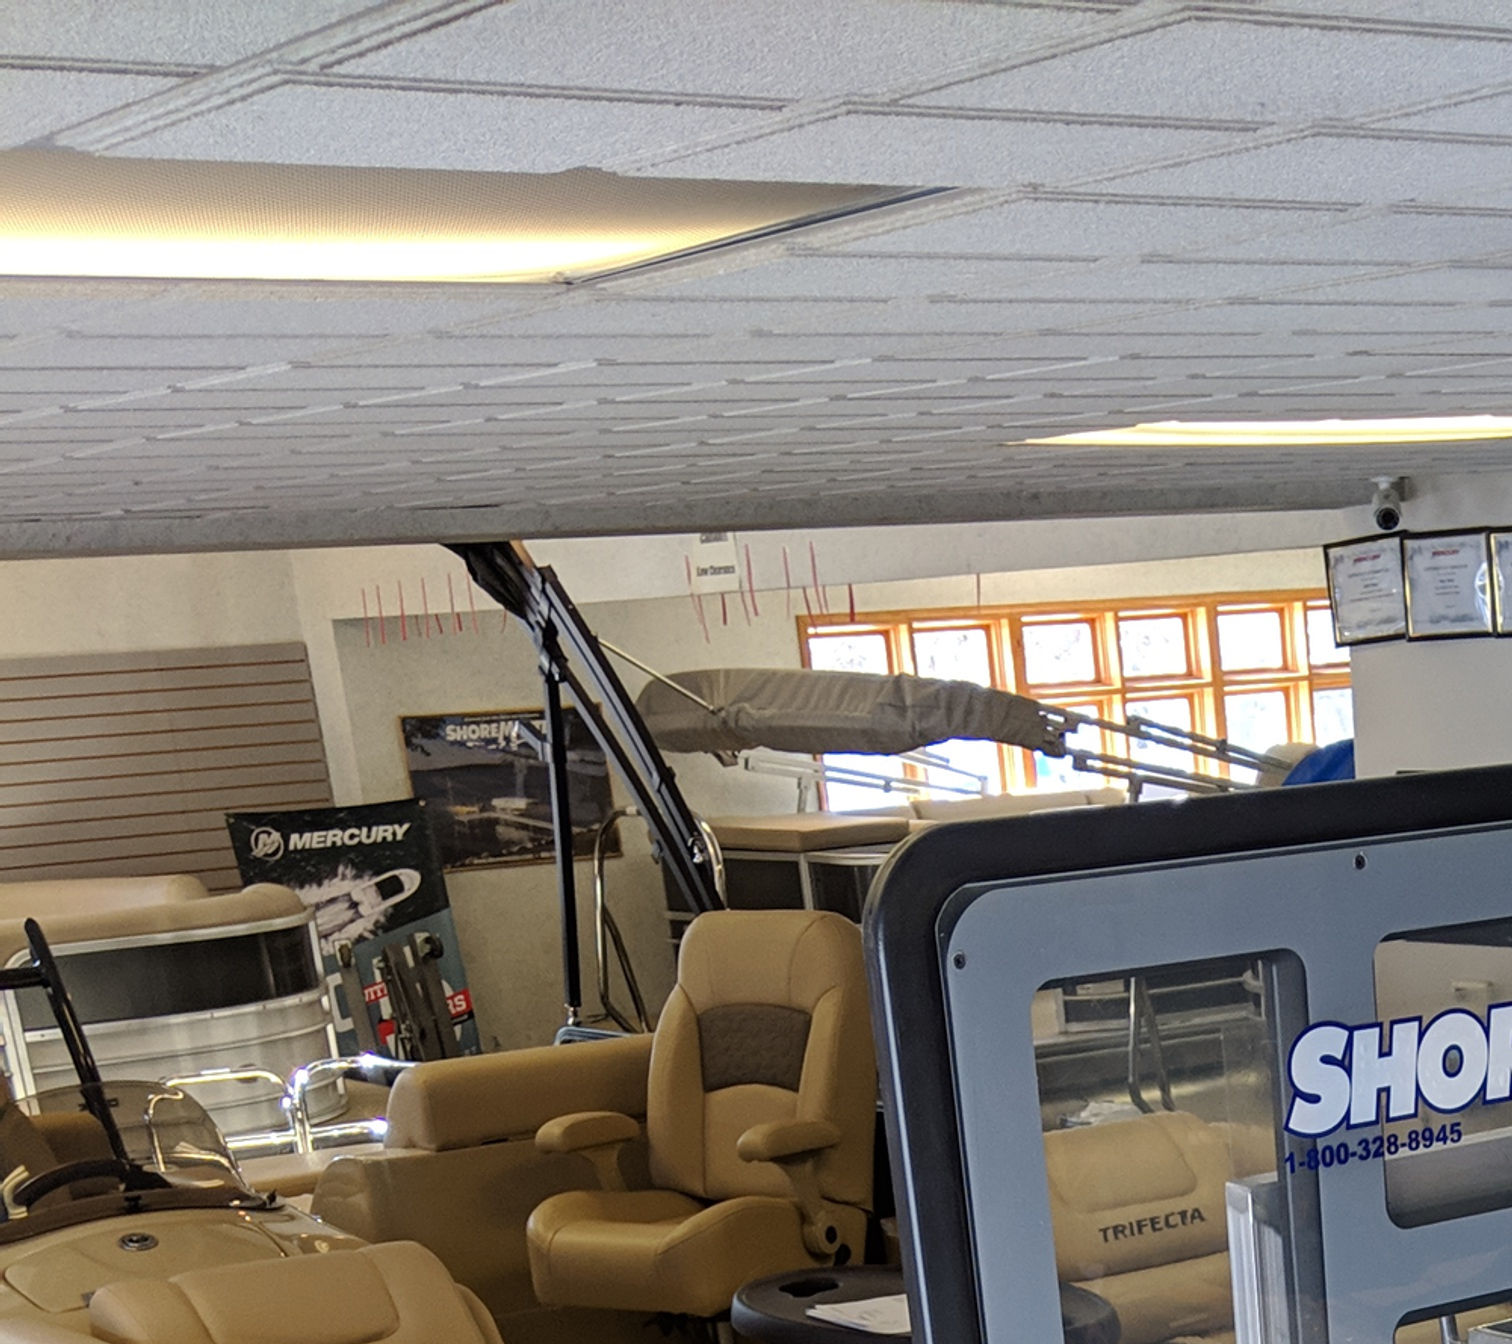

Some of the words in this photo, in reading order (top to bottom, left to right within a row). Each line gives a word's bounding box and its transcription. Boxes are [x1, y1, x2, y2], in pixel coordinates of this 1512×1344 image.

[288, 823, 411, 852] MERCURY
[1284, 1122, 1463, 1175] 1-800-328-8945
[1099, 1206, 1206, 1245] TRIFECTA
